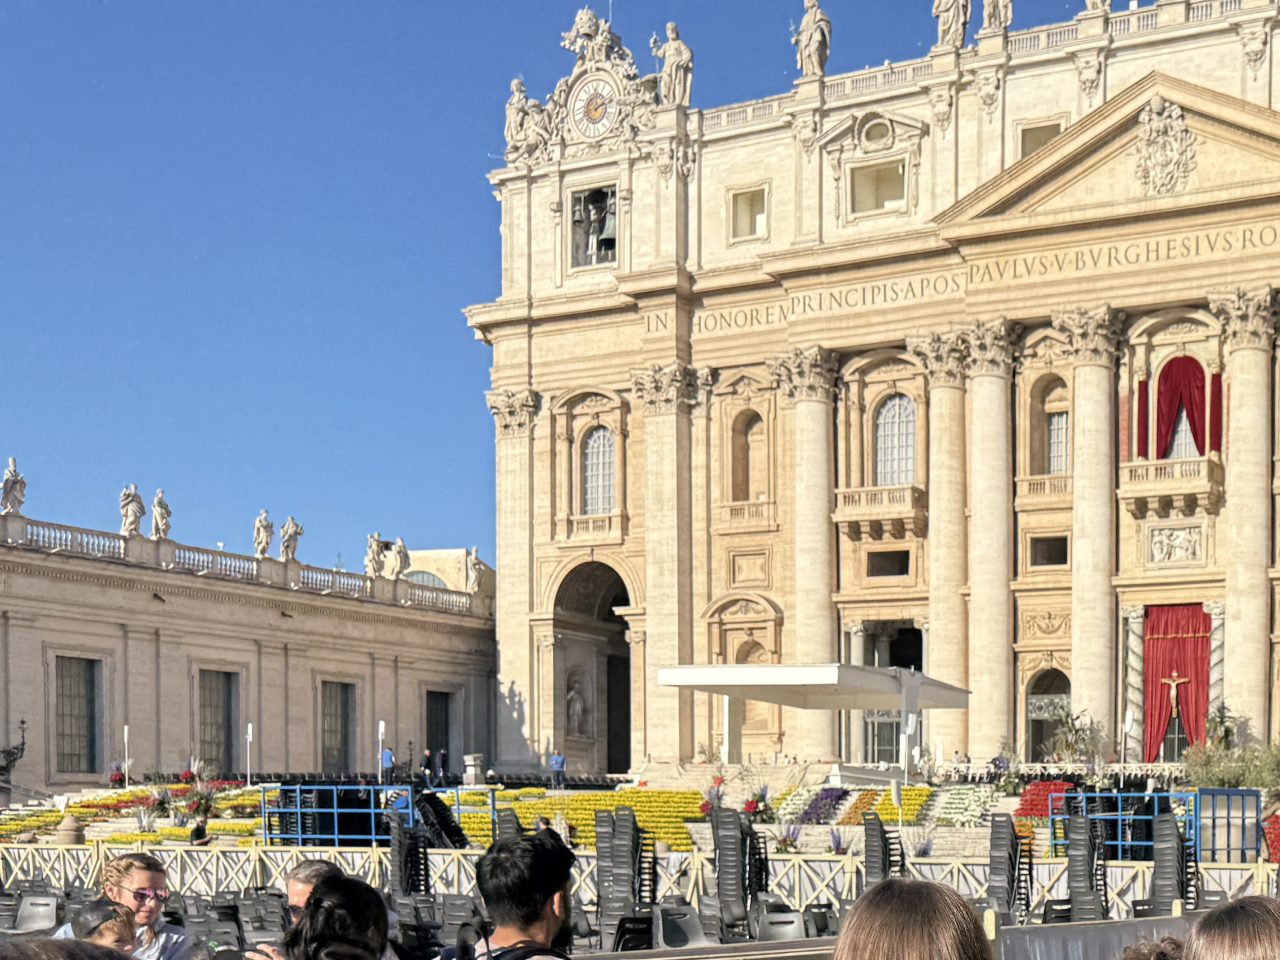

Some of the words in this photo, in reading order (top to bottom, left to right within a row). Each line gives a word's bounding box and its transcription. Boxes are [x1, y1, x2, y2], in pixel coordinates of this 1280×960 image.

[646, 312, 668, 333] IN
[791, 281, 899, 315] PRINCIPIS
[969, 255, 1048, 284] PAVLVS
[1075, 231, 1233, 271] BVRGHESIVS
